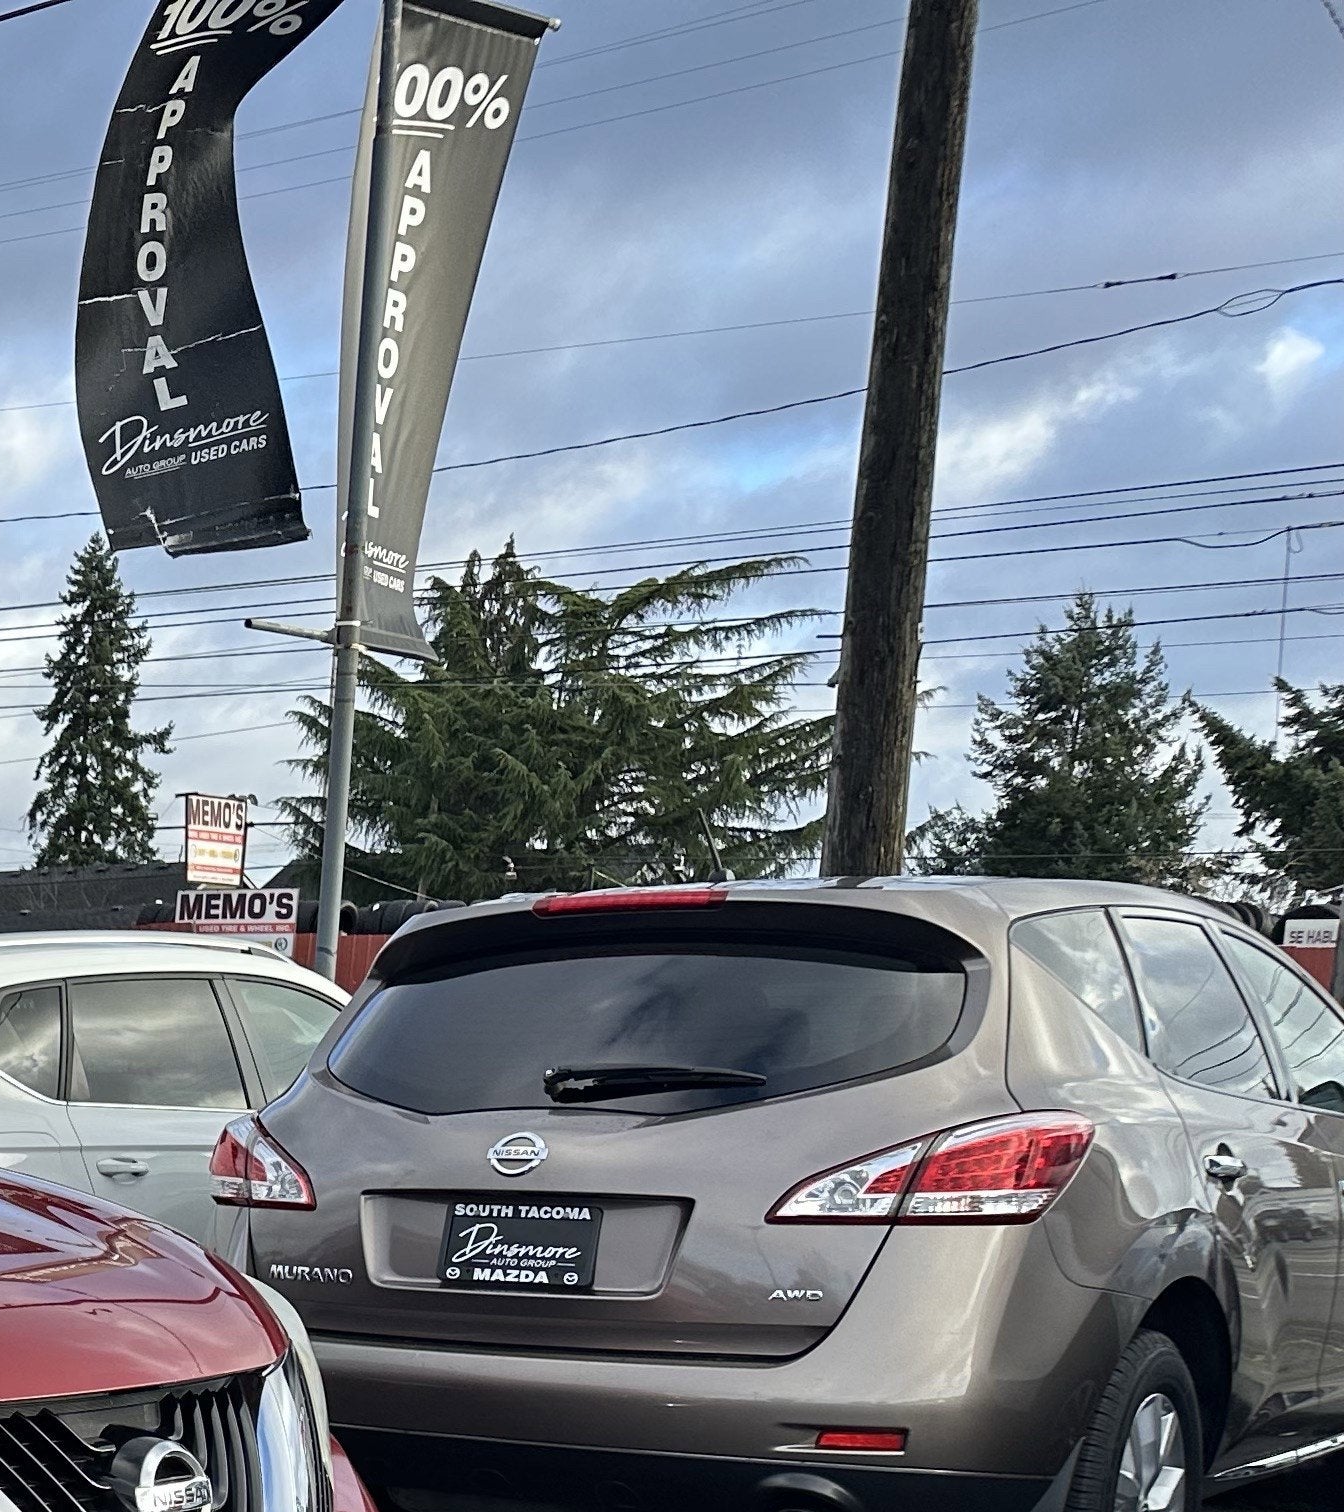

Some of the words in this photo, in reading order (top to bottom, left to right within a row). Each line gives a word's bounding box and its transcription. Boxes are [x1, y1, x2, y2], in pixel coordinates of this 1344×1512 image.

[157, 0, 309, 40] 100%
[393, 63, 510, 130] 00%
[137, 55, 202, 412] APPROVAL
[367, 149, 431, 519] APPROVAL
[98, 410, 270, 476] Dinsmore
[125, 463, 150, 477] AUTO
[152, 453, 187, 472] GROUP
[190, 443, 228, 465] USED
[229, 434, 268, 455] CARS
[188, 798, 244, 831] MEMO'S
[179, 892, 294, 920] MEMO'S
[1289, 930, 1304, 943] SE
[491, 1148, 541, 1157] NISSAN
[454, 1203, 514, 1218] SOUTH
[518, 1205, 592, 1220] TACOMA
[451, 1222, 582, 1263] Dinsmore
[269, 1264, 353, 1283] MURANO
[472, 1268, 550, 1284] MAZDA
[489, 1257, 519, 1267] AUTO
[520, 1258, 557, 1268] GROUP
[767, 1289, 824, 1301] AWD
